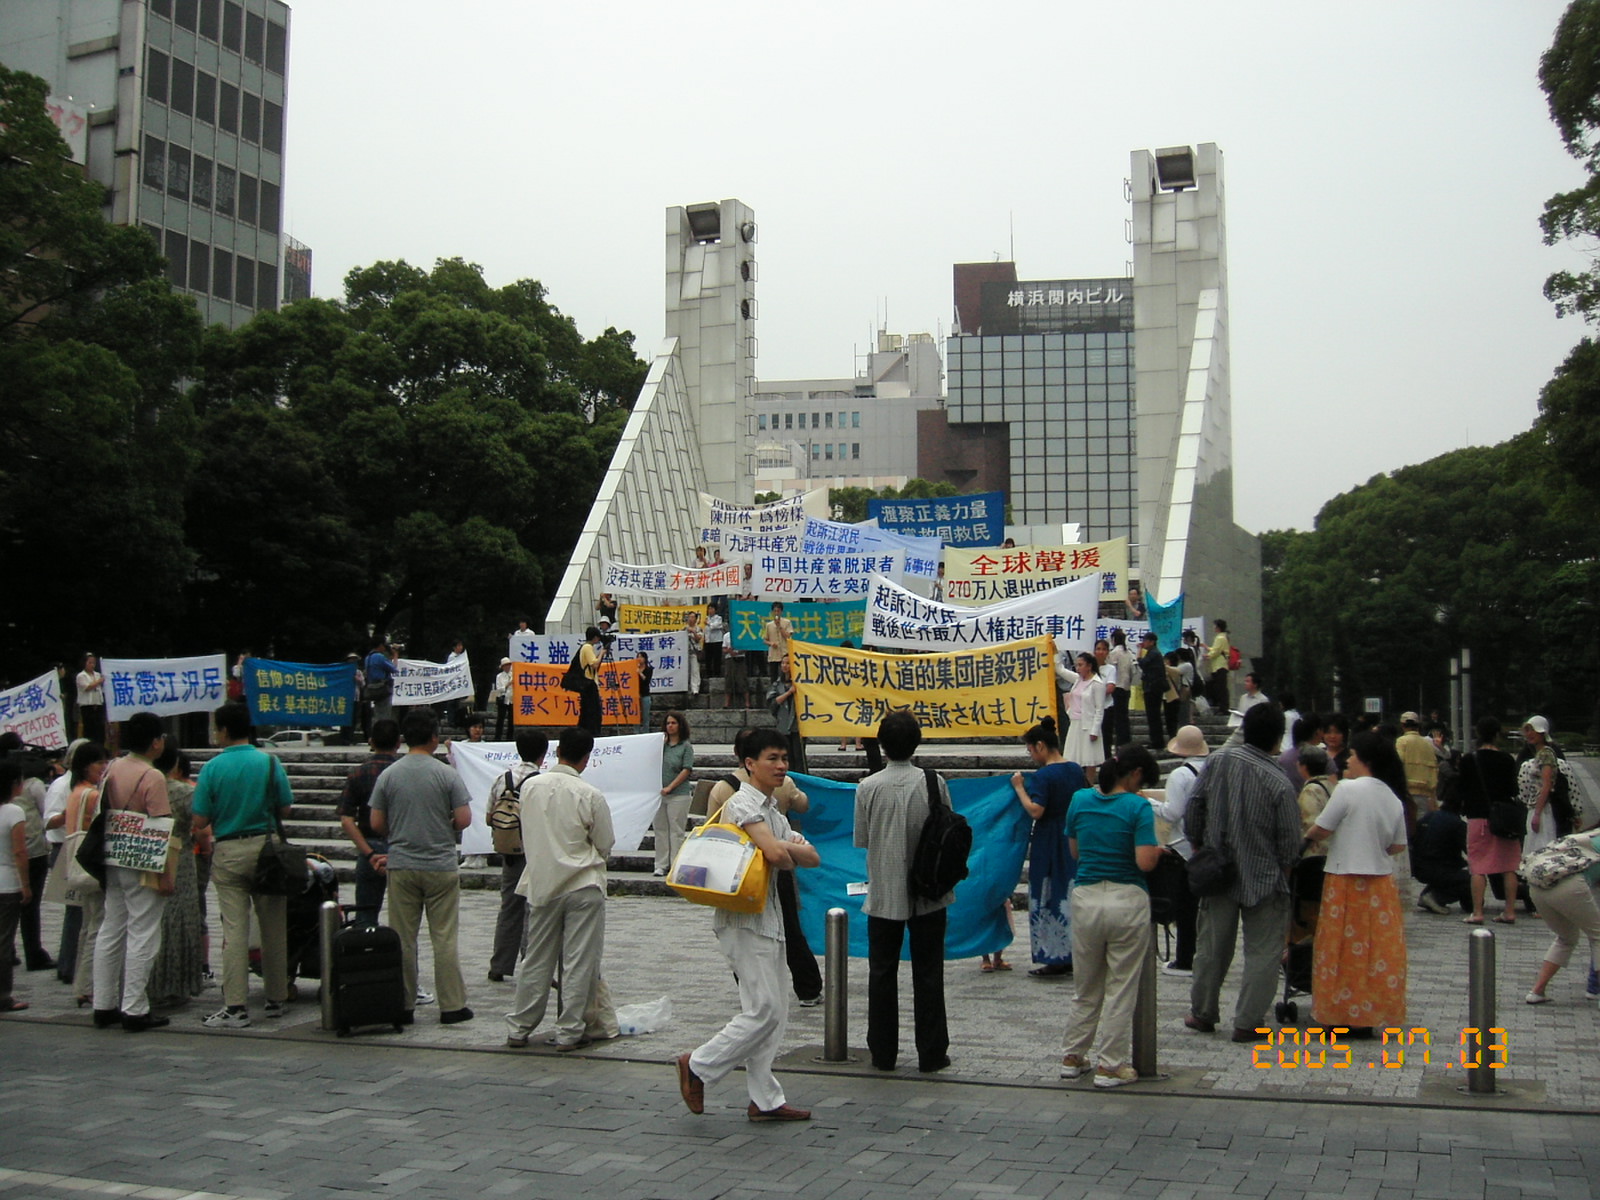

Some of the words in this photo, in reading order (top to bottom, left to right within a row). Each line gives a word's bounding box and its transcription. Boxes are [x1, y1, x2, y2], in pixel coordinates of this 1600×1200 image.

[1007, 287, 1123, 307] 横浜関内ビル
[884, 523, 991, 543] 救国救民
[970, 546, 1101, 577] 全球聲援
[949, 572, 1117, 600] 270万人退出中国黨
